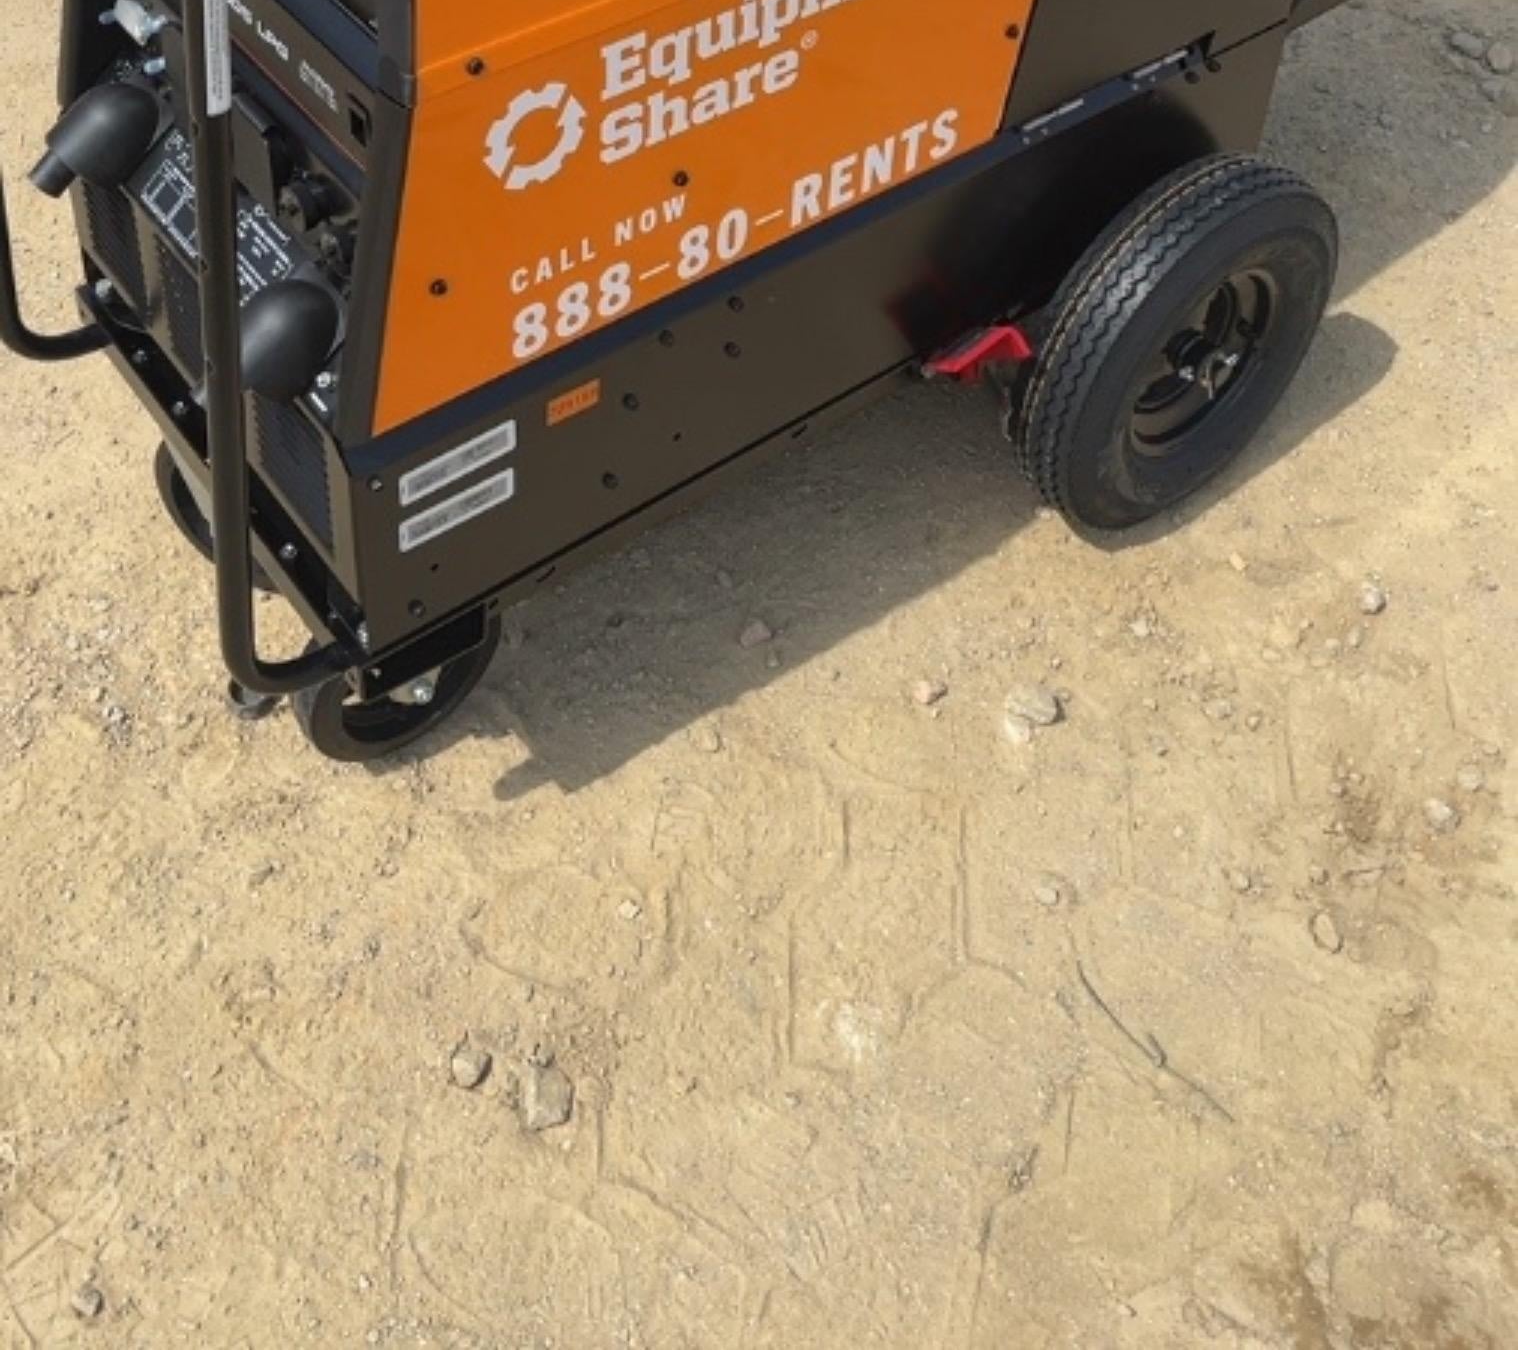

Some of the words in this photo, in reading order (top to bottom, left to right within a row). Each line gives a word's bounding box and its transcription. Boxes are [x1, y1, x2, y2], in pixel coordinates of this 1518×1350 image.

[510, 237, 596, 295] CALL
[614, 192, 687, 247] NOW
[512, 108, 959, 360] 888-80-RENTS
